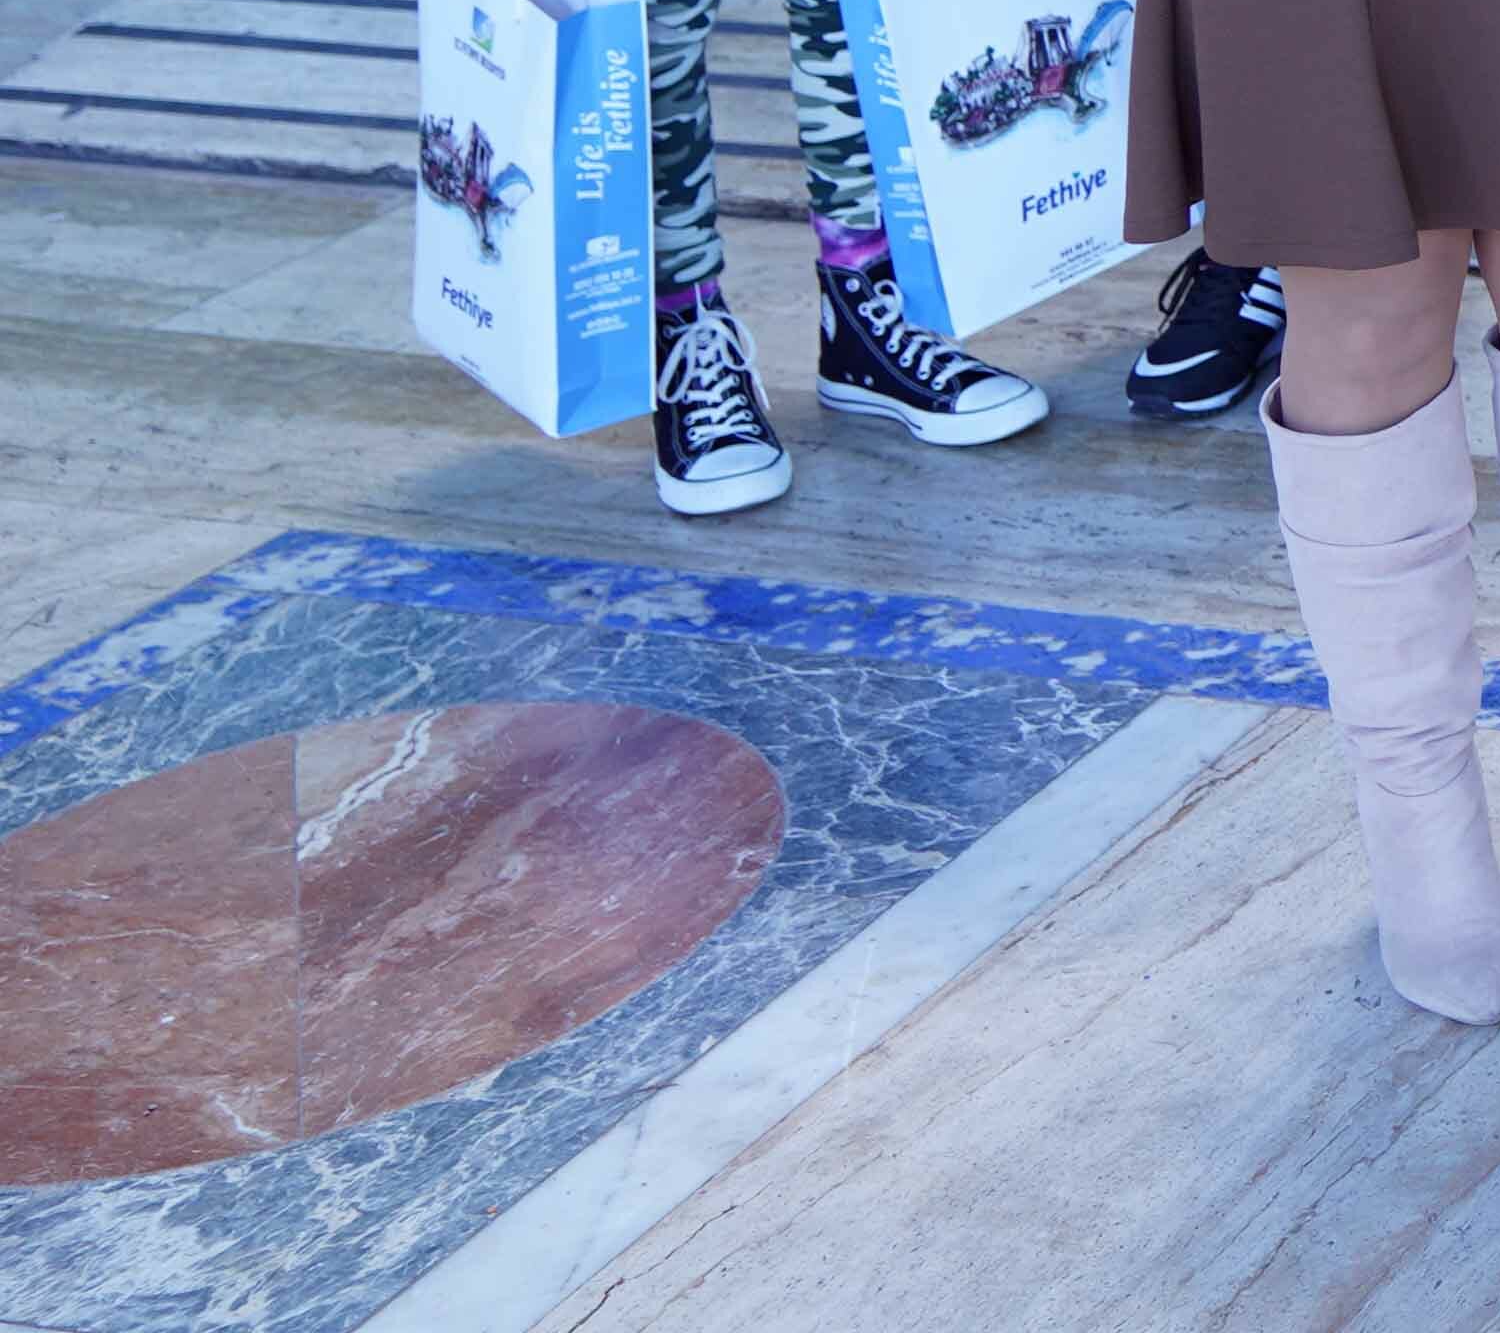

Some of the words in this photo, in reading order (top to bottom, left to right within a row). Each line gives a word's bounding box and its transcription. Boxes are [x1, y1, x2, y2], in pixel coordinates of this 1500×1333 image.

[571, 111, 601, 136] is
[601, 47, 638, 153] Fethiye
[575, 145, 613, 201] Life
[1020, 165, 1109, 223] Fethiye
[441, 276, 494, 331] Fethiye
